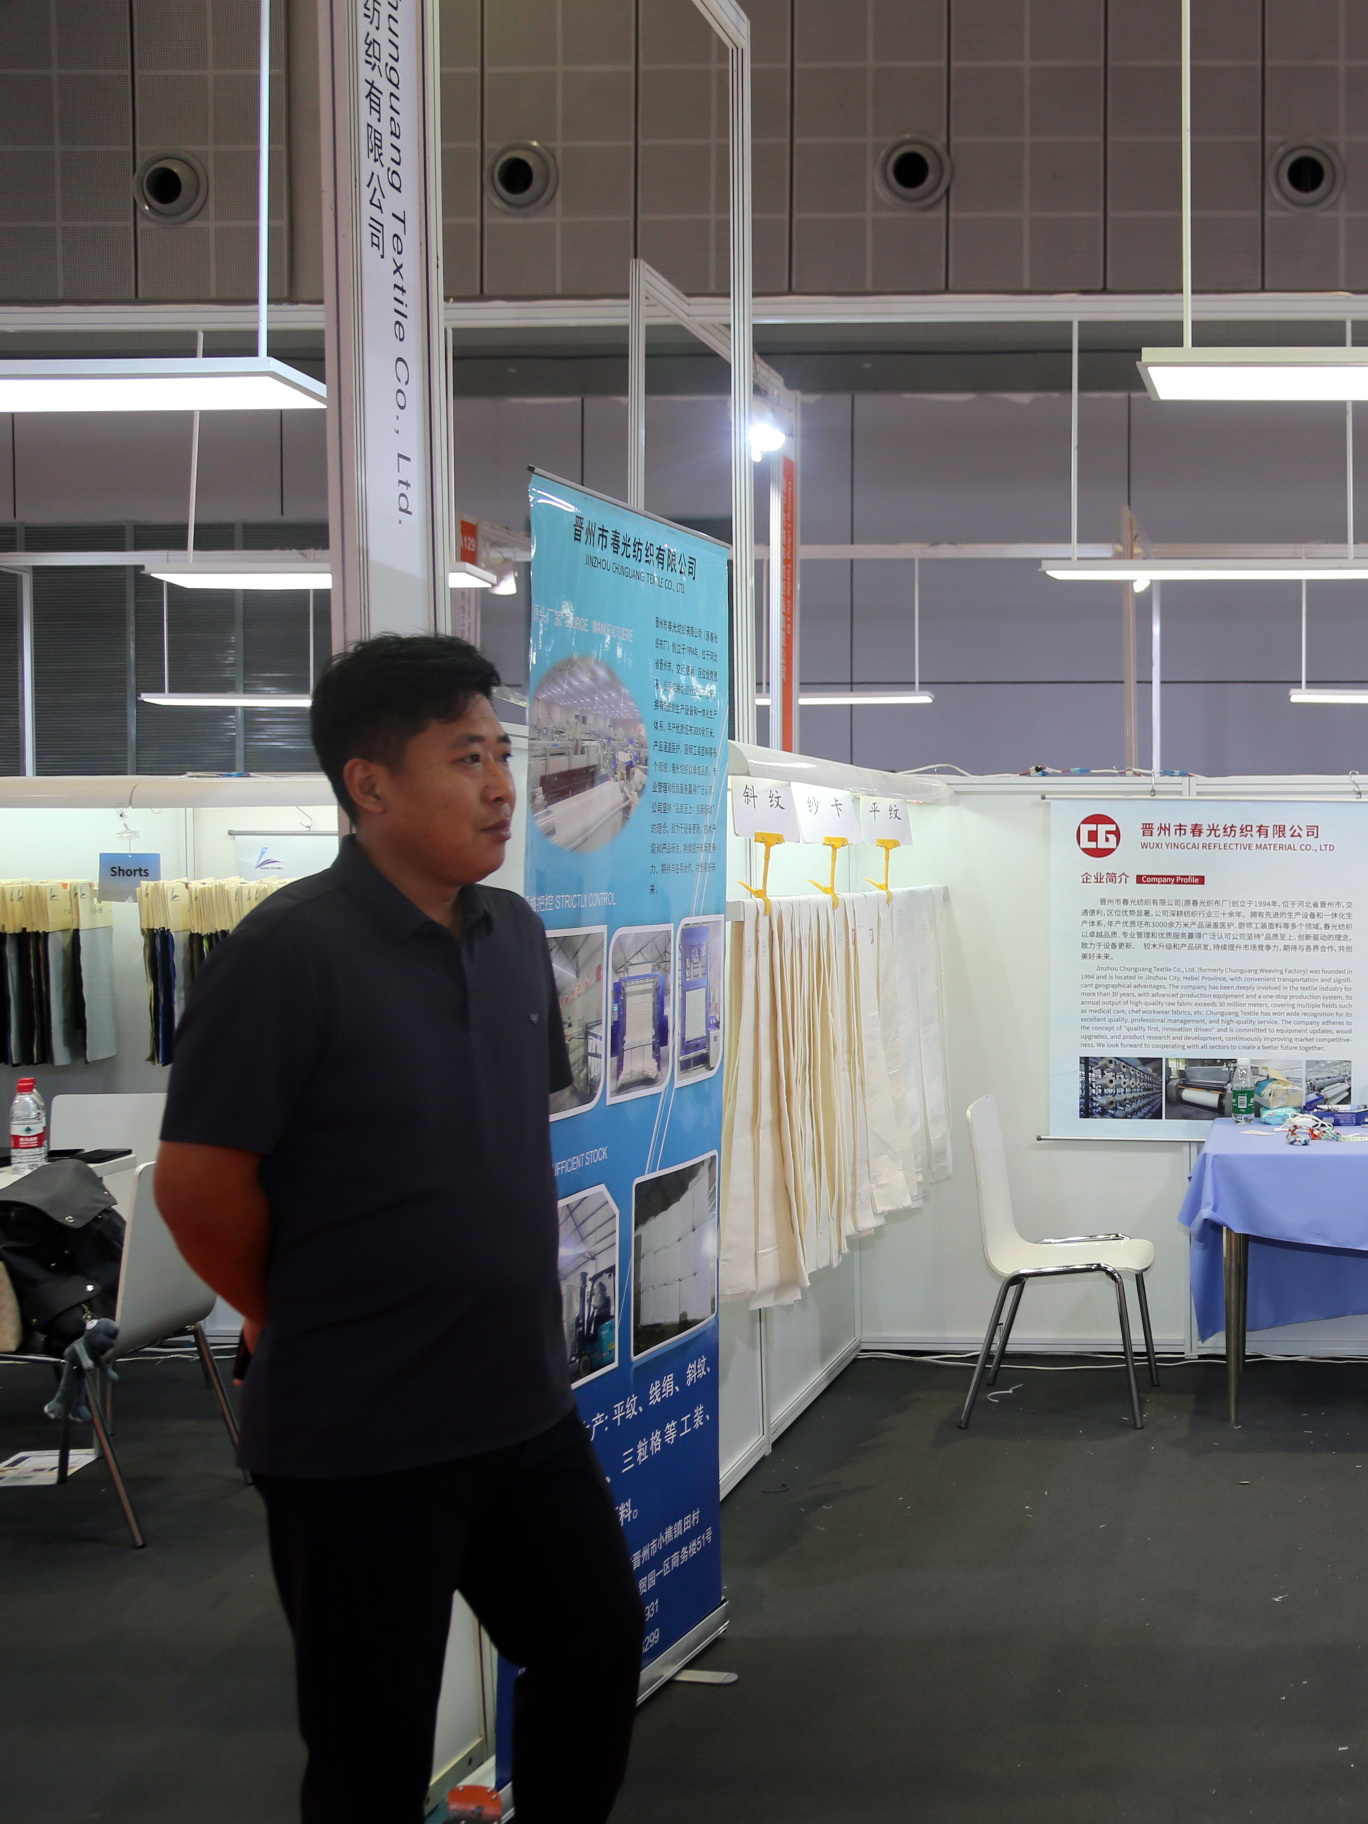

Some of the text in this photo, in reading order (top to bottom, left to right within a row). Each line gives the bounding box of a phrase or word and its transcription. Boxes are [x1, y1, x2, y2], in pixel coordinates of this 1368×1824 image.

[391, 210, 409, 342] Textile
[394, 356, 410, 434] Co.,
[397, 452, 413, 525] Ltd.
[573, 515, 697, 581] 晋州市春光纺织有限公司
[585, 554, 611, 572] JINZHOU
[612, 562, 645, 582] CHUNGUANG
[742, 784, 786, 810] 斜纹
[868, 801, 903, 822] 平纹
[1140, 822, 1320, 839] 晋州市春光纺织有限公司
[1140, 842, 1335, 853] WUXI YINGCAI REFLECTIVE MATERIAL CO., LTD
[109, 866, 150, 879] Shorts
[1080, 872, 1130, 884] 企业简介
[1141, 876, 1199, 884] Company Profile
[1120, 966, 1152, 974] Chunguang
[1197, 967, 1223, 975] (formerly
[1225, 967, 1258, 975] Chunguang
[1259, 968, 1283, 976] Weaving
[1285, 968, 1307, 976] Factory)
[1169, 975, 1181, 983] City,
[1201, 976, 1228, 984] Province,
[1277, 977, 1319, 985] transportation
[1333, 977, 1352, 985] signifi-
[1095, 983, 1132, 991] geographical
[1133, 983, 1167, 991] advantages.
[1236, 985, 1255, 993] deeply
[1319, 986, 1342, 994] industry
[585, 1146, 608, 1166] STOCK
[615, 1498, 638, 1527] 料。
[642, 1627, 660, 1653] 299
